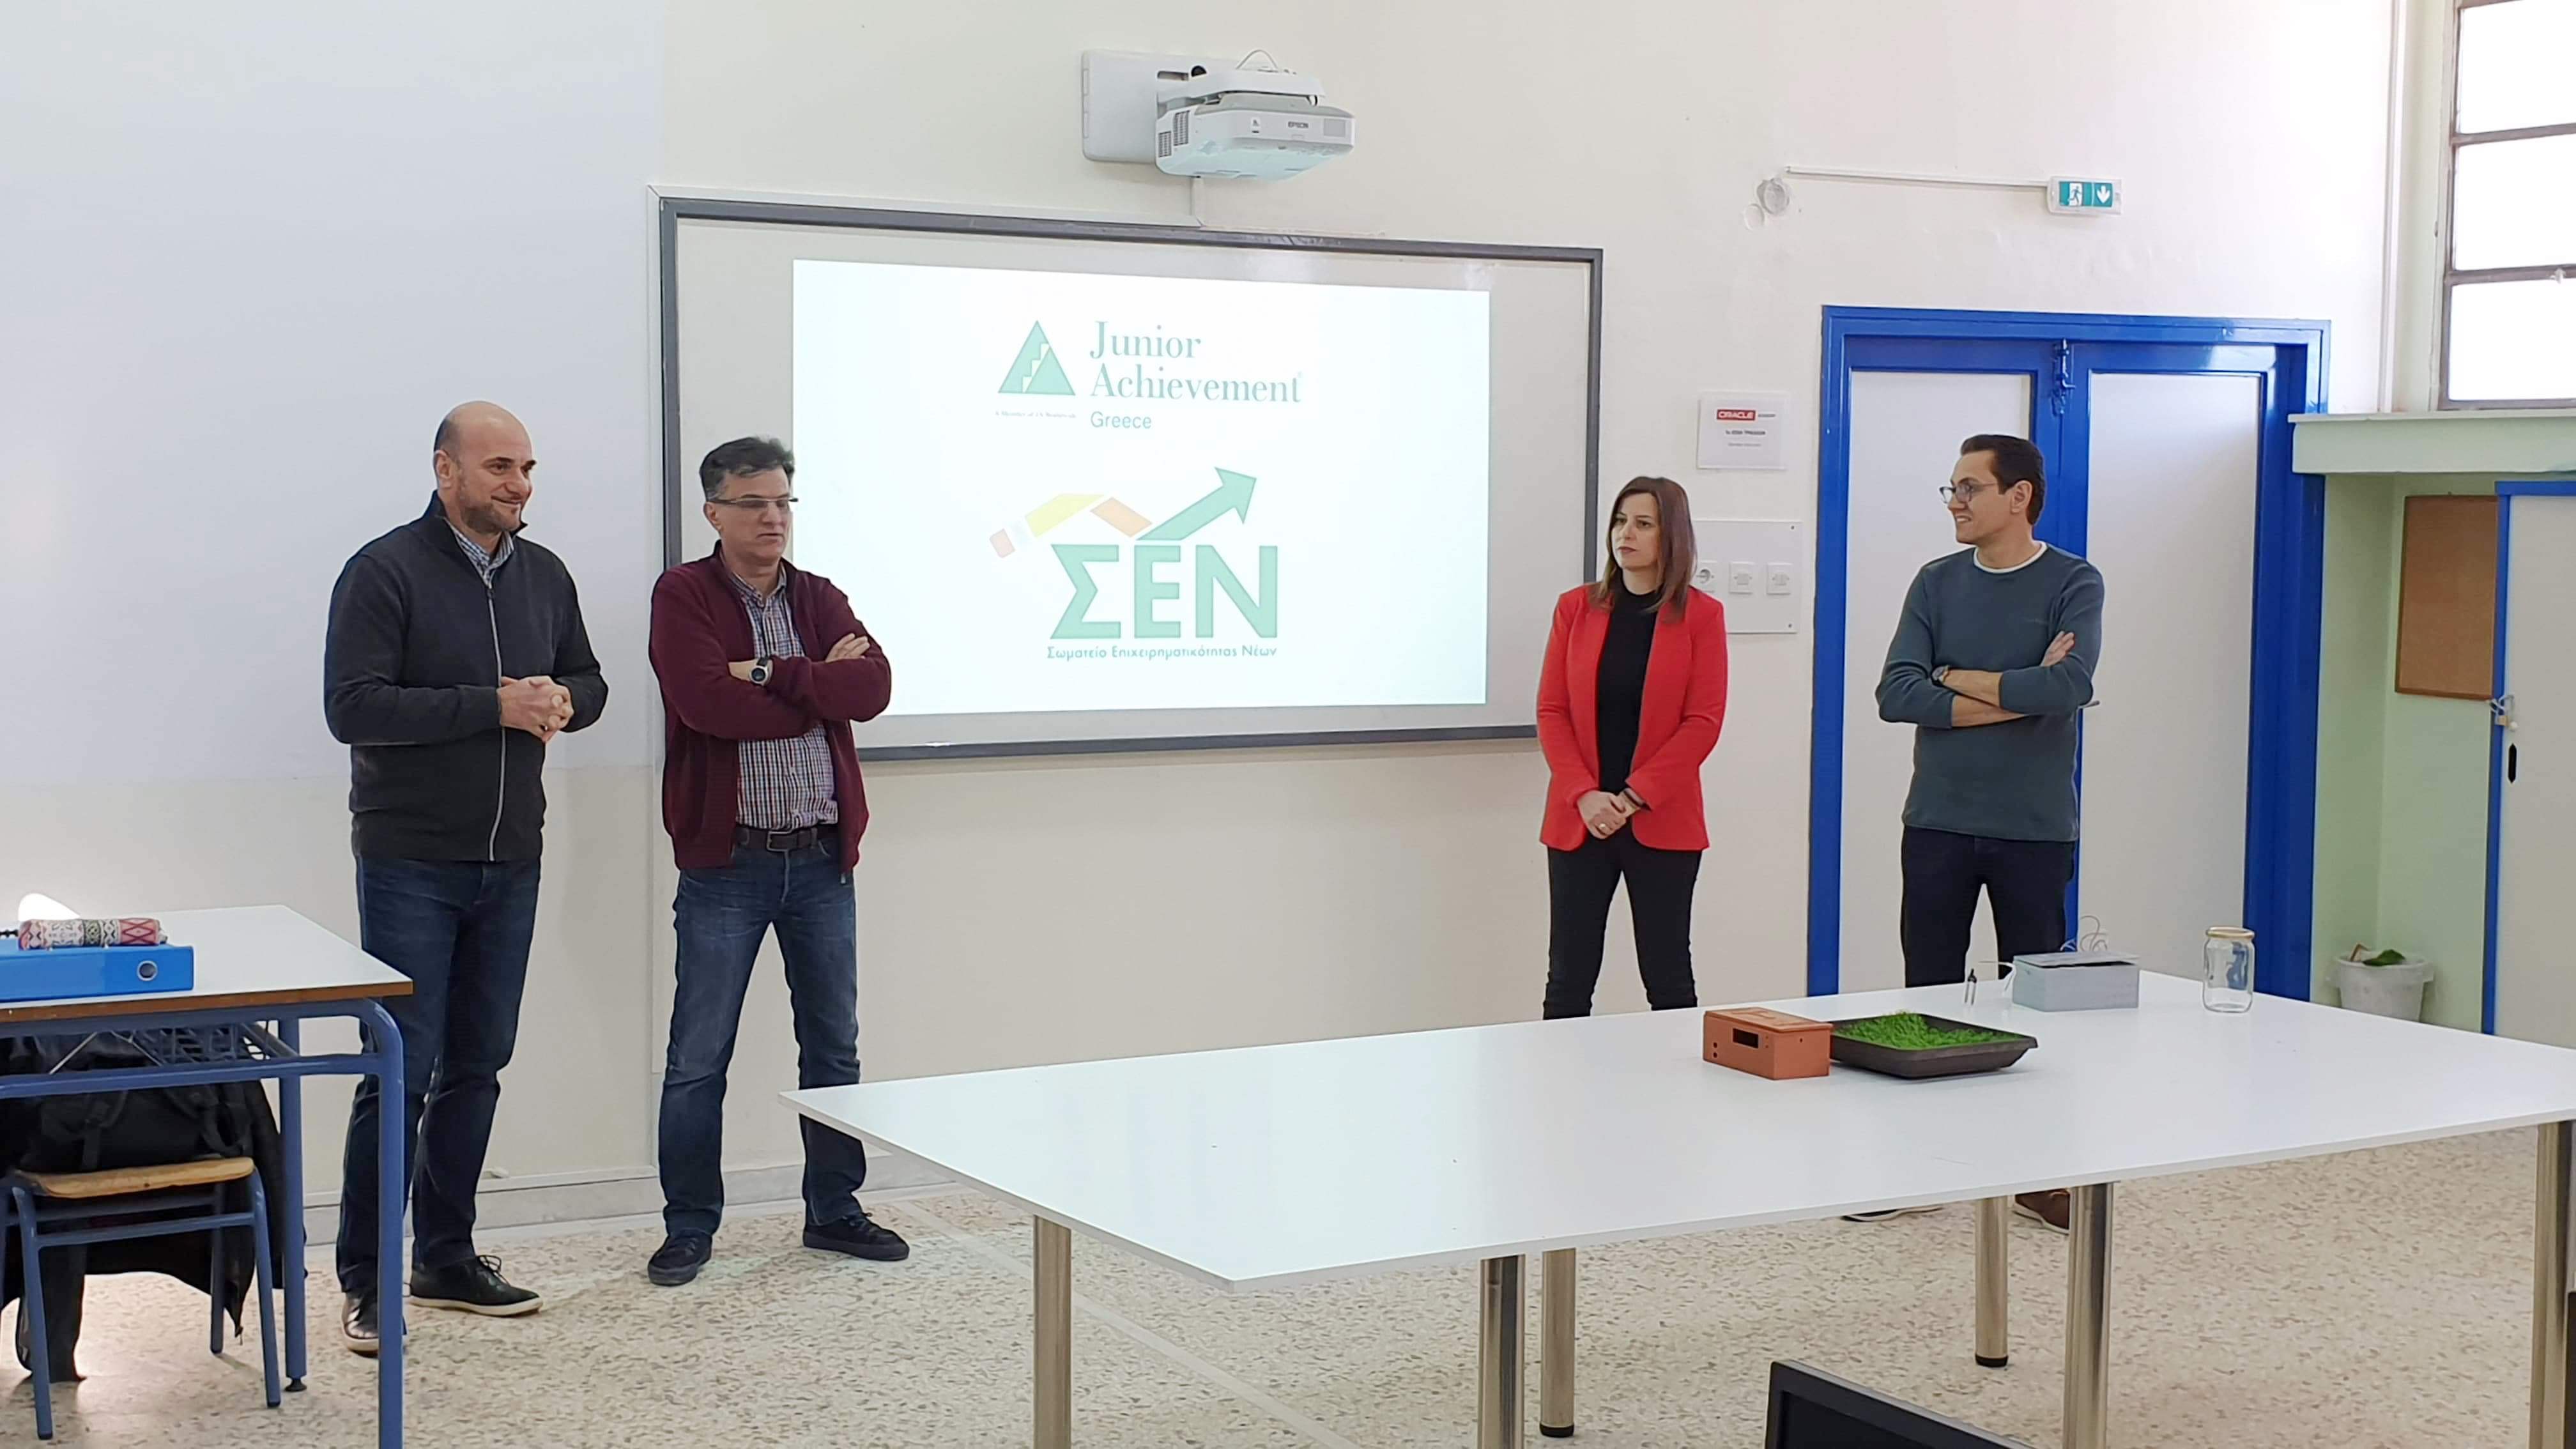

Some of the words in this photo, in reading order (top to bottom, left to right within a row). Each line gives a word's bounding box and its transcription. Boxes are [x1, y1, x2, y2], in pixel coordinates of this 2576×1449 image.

[1089, 321, 1202, 359] Junior
[1090, 362, 1301, 403] Achievement
[1090, 411, 1152, 429] Greece
[1718, 410, 1754, 419] ORACLE
[1050, 543, 1278, 640] ΣΕΝ
[1046, 645, 1108, 662] Σωματείο
[1111, 644, 1238, 661] Επιχειρηματικότητας
[1241, 644, 1277, 657] Νέων
